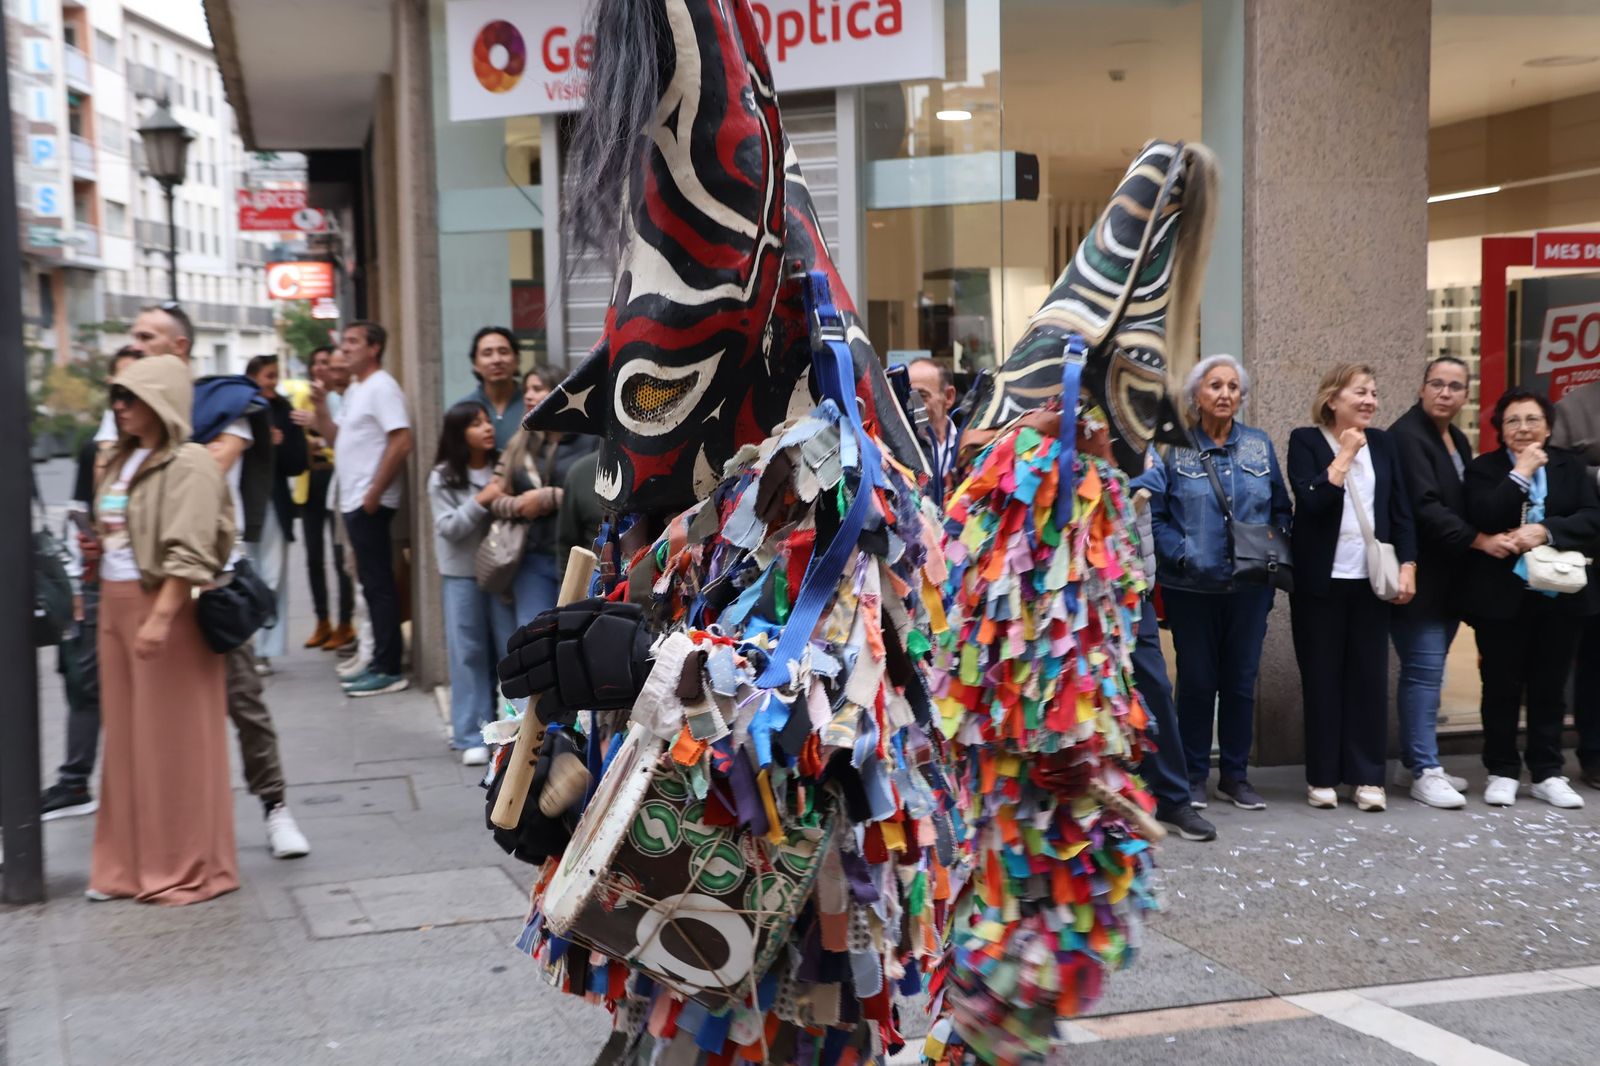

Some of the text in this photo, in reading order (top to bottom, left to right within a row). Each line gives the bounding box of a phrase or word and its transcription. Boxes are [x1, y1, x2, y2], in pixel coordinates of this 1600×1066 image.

[541, 26, 597, 74] Ge
[1544, 243, 1581, 260] MES
[1546, 312, 1600, 362] 50
